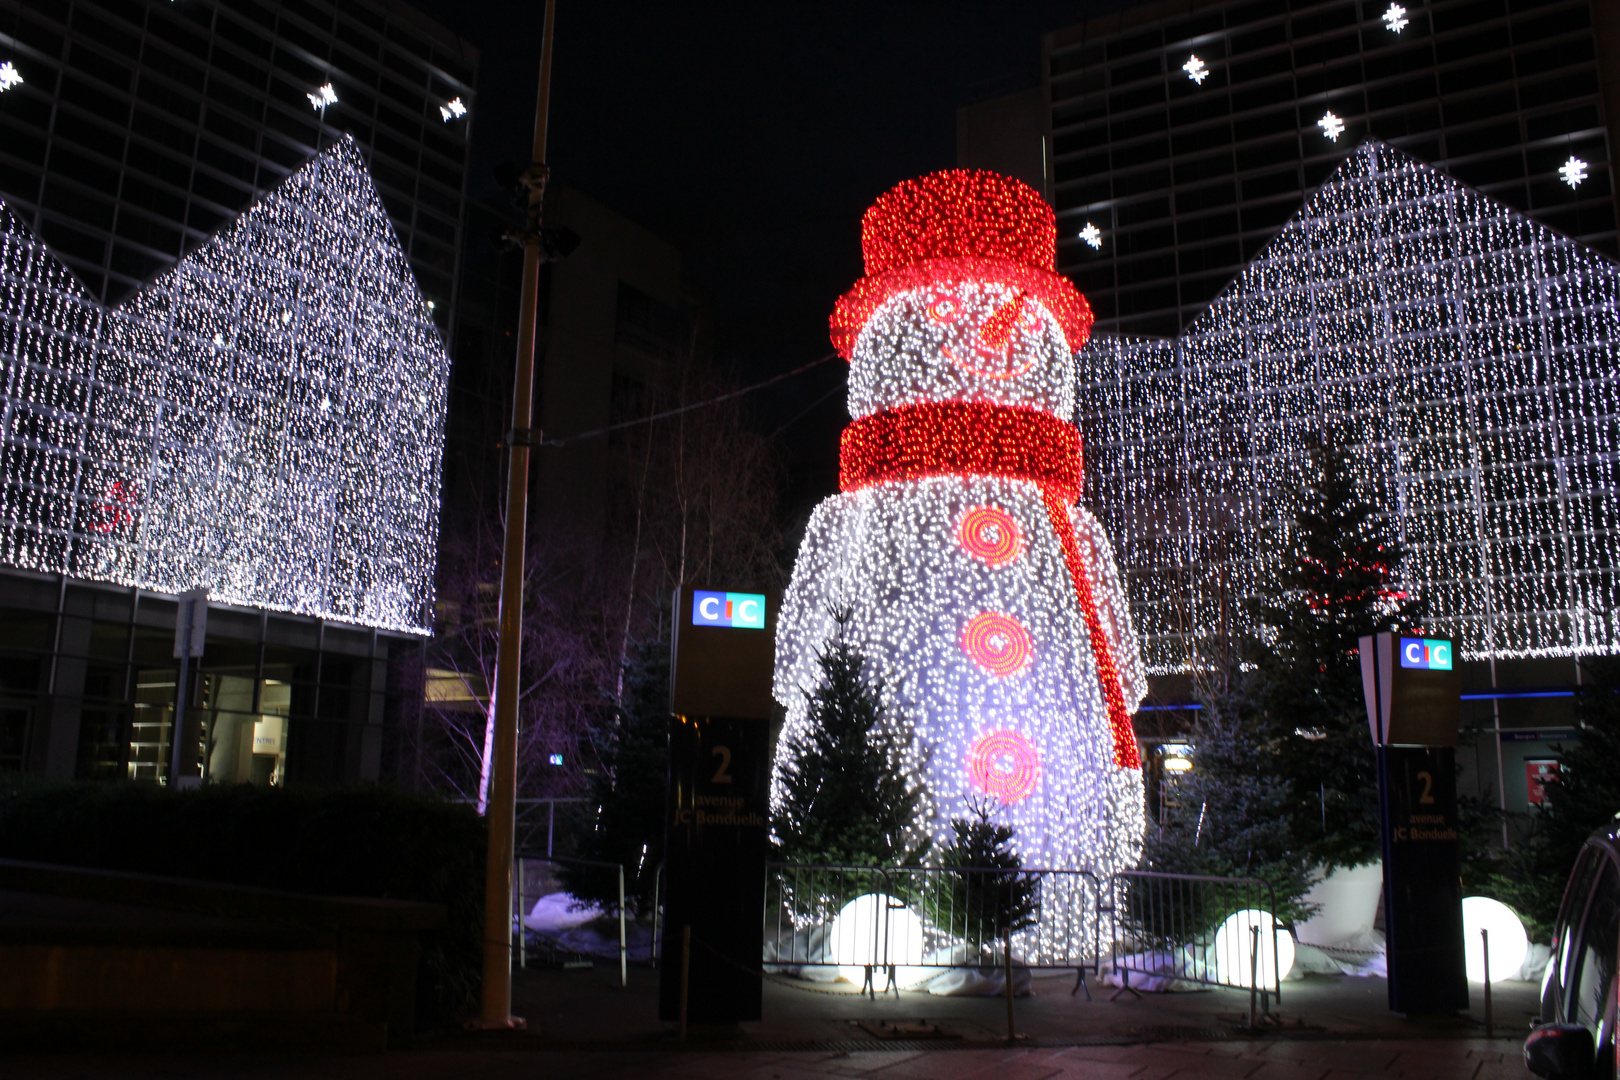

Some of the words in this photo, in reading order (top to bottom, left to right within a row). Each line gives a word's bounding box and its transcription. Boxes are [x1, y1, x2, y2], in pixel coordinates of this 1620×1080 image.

[699, 597, 758, 621] CIC
[1405, 642, 1447, 664] CIC
[711, 745, 732, 784] 2
[1418, 771, 1435, 804] 2
[696, 796, 745, 811] avenue
[673, 808, 692, 827] JC
[696, 811, 764, 827] Bonduelle
[1409, 815, 1445, 826] avenue
[1393, 827, 1408, 843] JC
